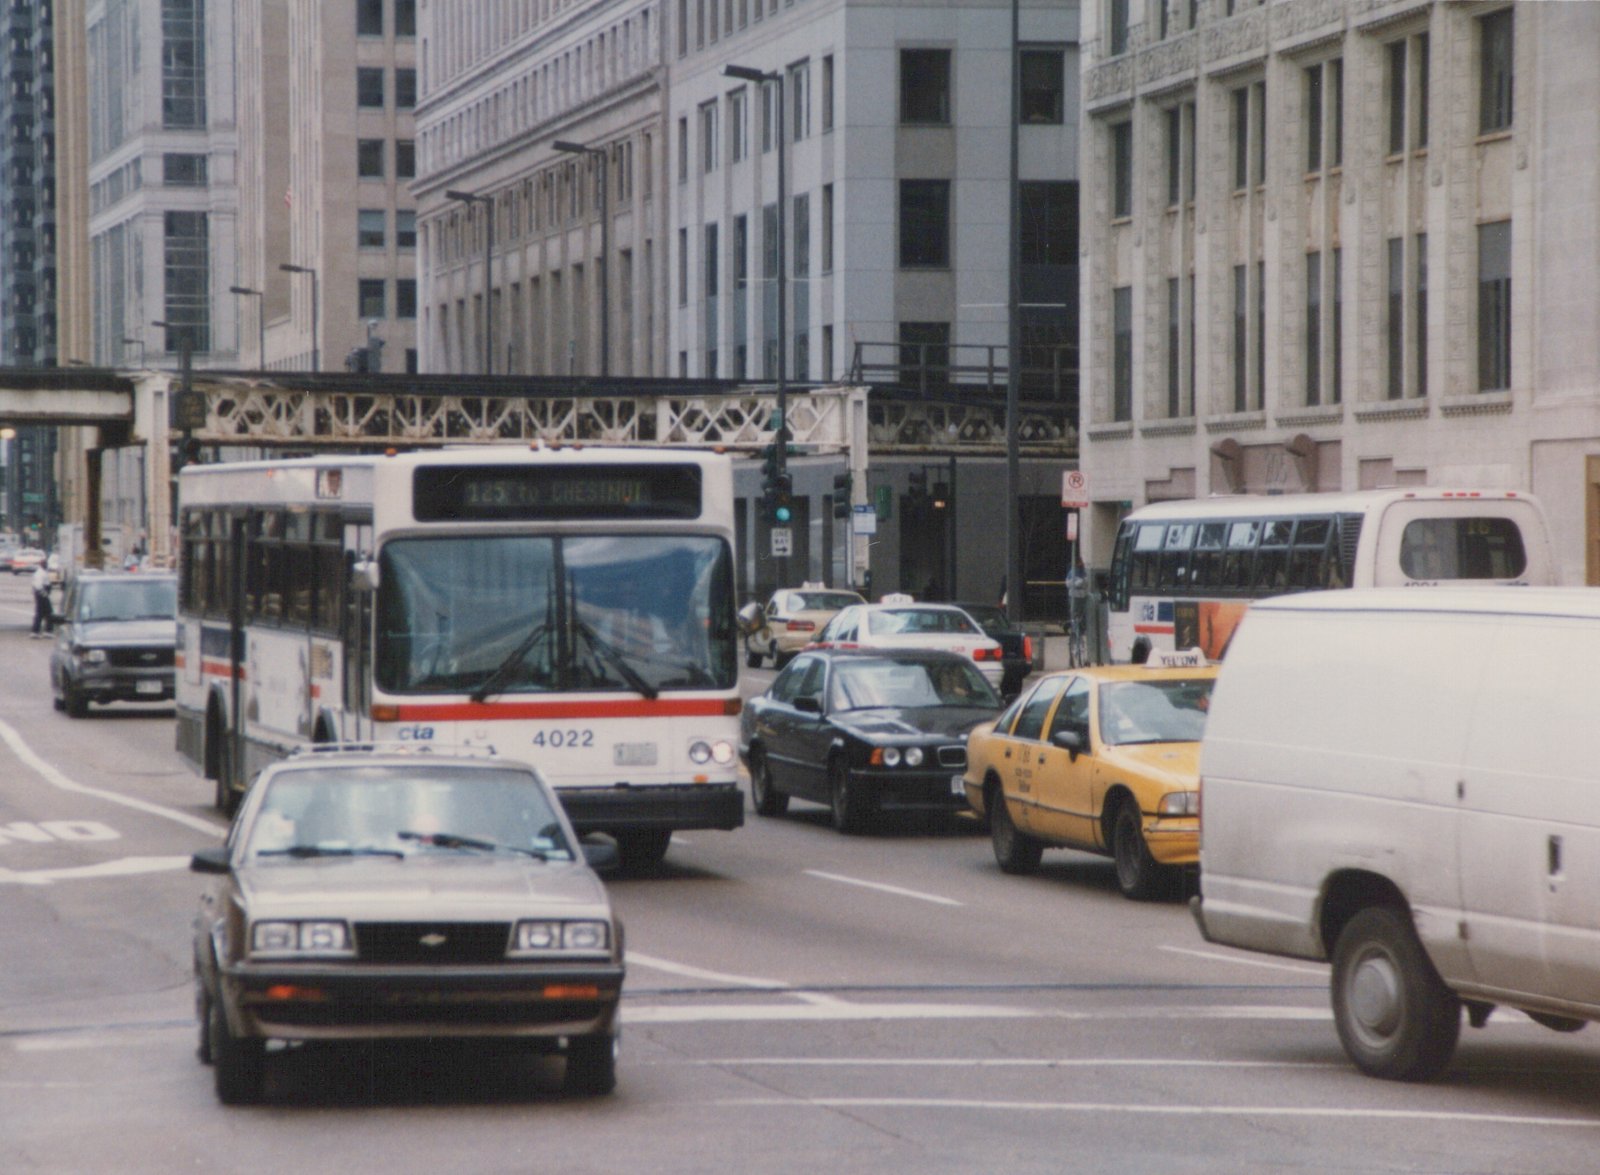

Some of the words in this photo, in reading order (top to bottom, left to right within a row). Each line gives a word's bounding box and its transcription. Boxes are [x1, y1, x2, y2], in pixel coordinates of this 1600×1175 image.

[467, 482, 507, 503] 125
[399, 724, 434, 741] cta
[533, 730, 595, 748] 4022
